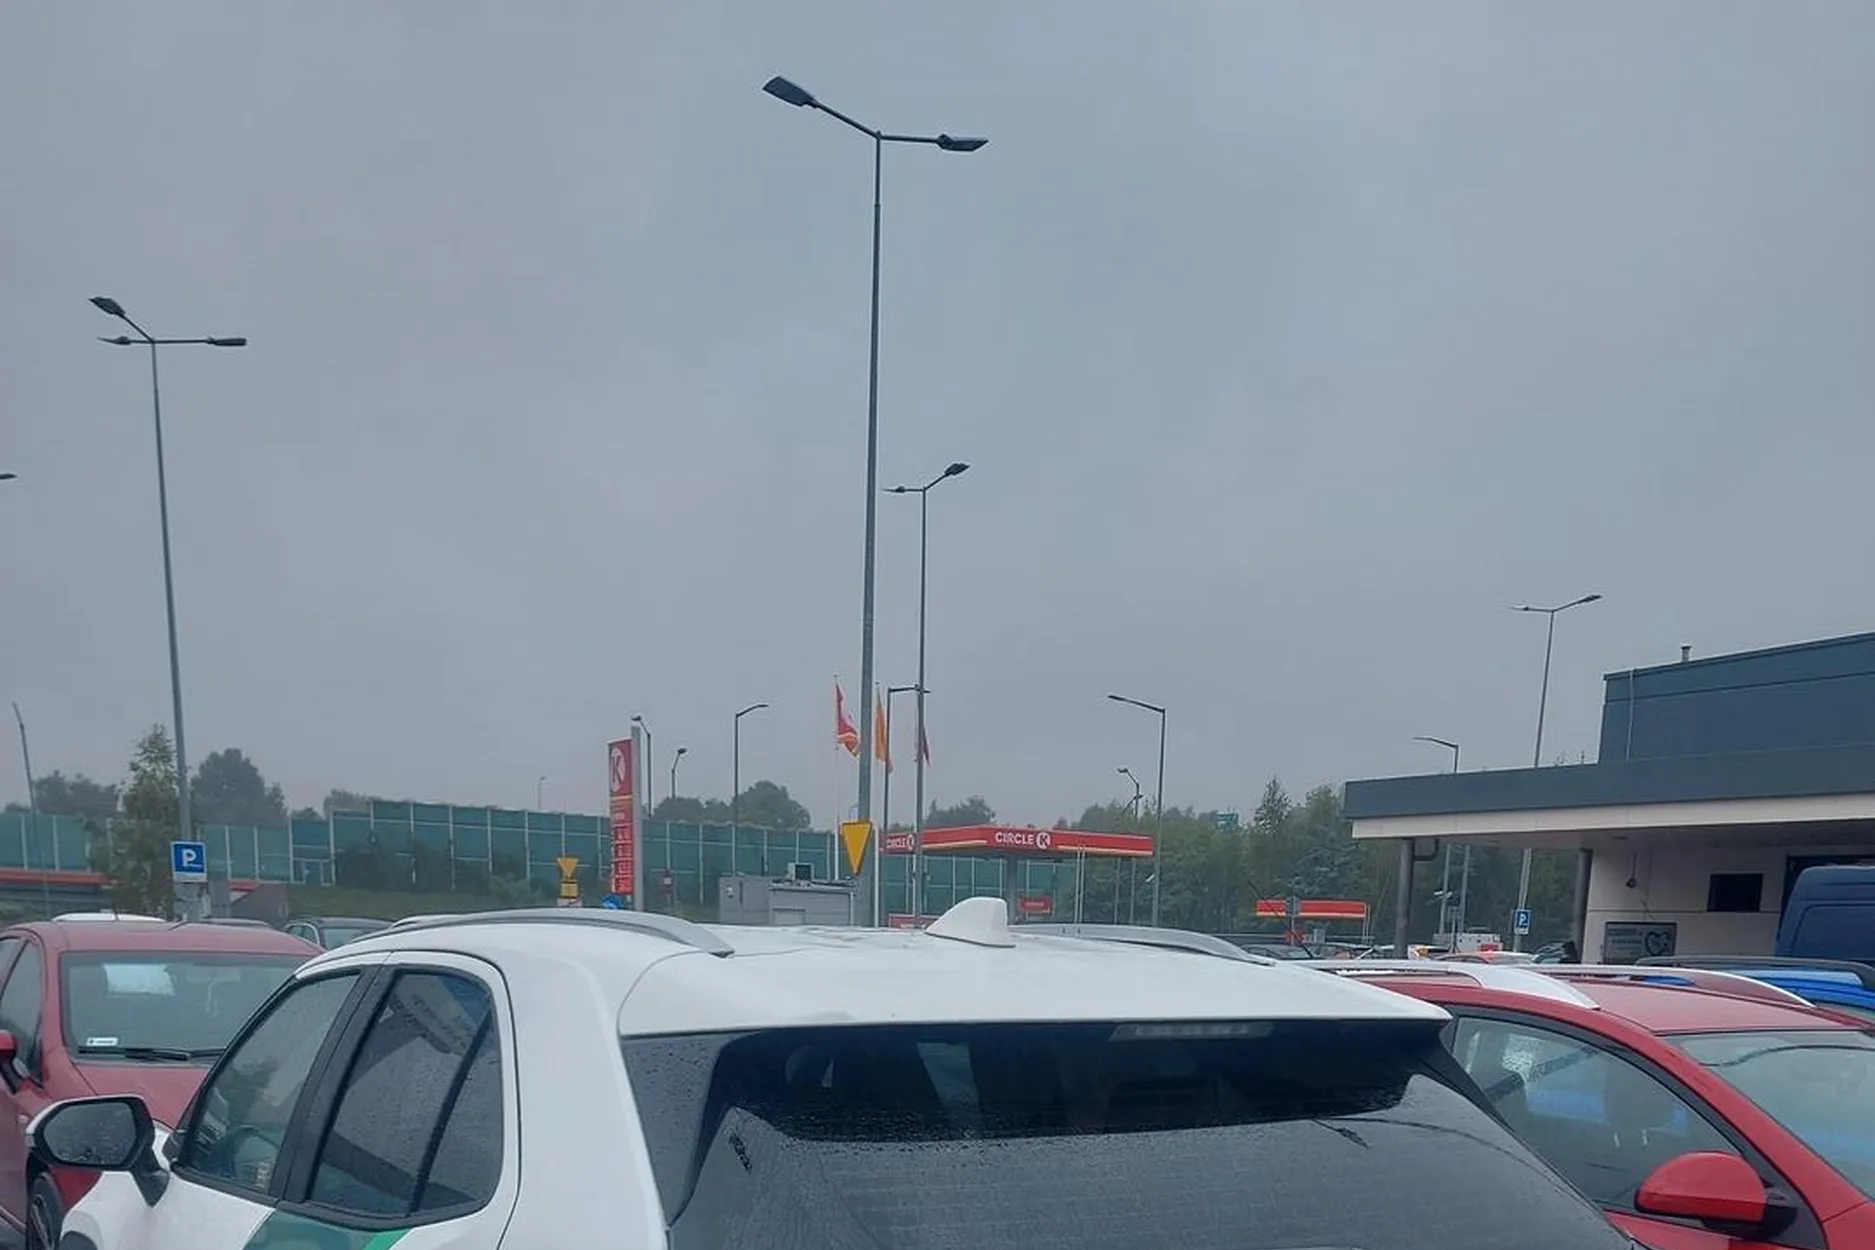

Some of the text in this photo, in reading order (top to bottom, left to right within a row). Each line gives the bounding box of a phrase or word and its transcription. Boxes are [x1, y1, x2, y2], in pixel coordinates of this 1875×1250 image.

[995, 832, 1051, 849] CIRCLE K
[182, 848, 197, 867] P
